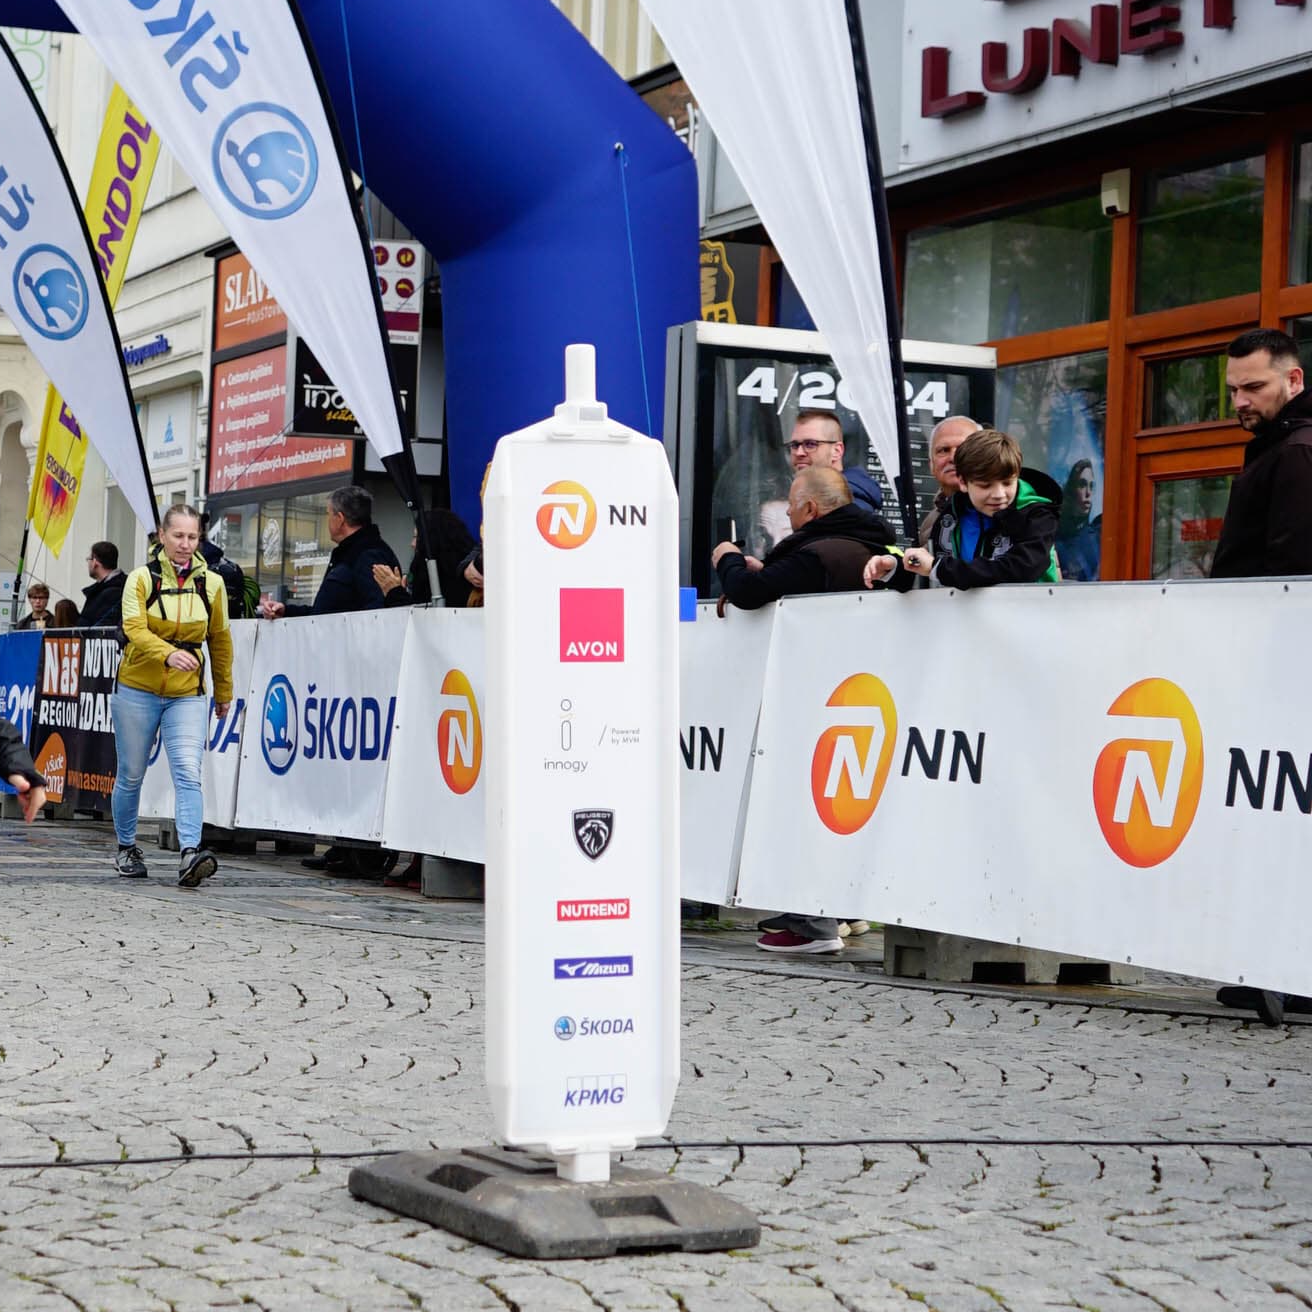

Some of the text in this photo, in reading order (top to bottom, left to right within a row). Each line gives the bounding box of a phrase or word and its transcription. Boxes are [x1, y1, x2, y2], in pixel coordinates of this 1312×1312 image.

[609, 505, 646, 526] NN
[566, 641, 618, 656] AVON
[39, 700, 77, 728] REGION
[544, 758, 588, 773] innogy
[902, 727, 986, 785] NN
[1225, 748, 1312, 814] NN
[561, 902, 628, 917] NUTREND
[579, 1017, 634, 1036] ŠKODA
[564, 1087, 624, 1107] KPMG
